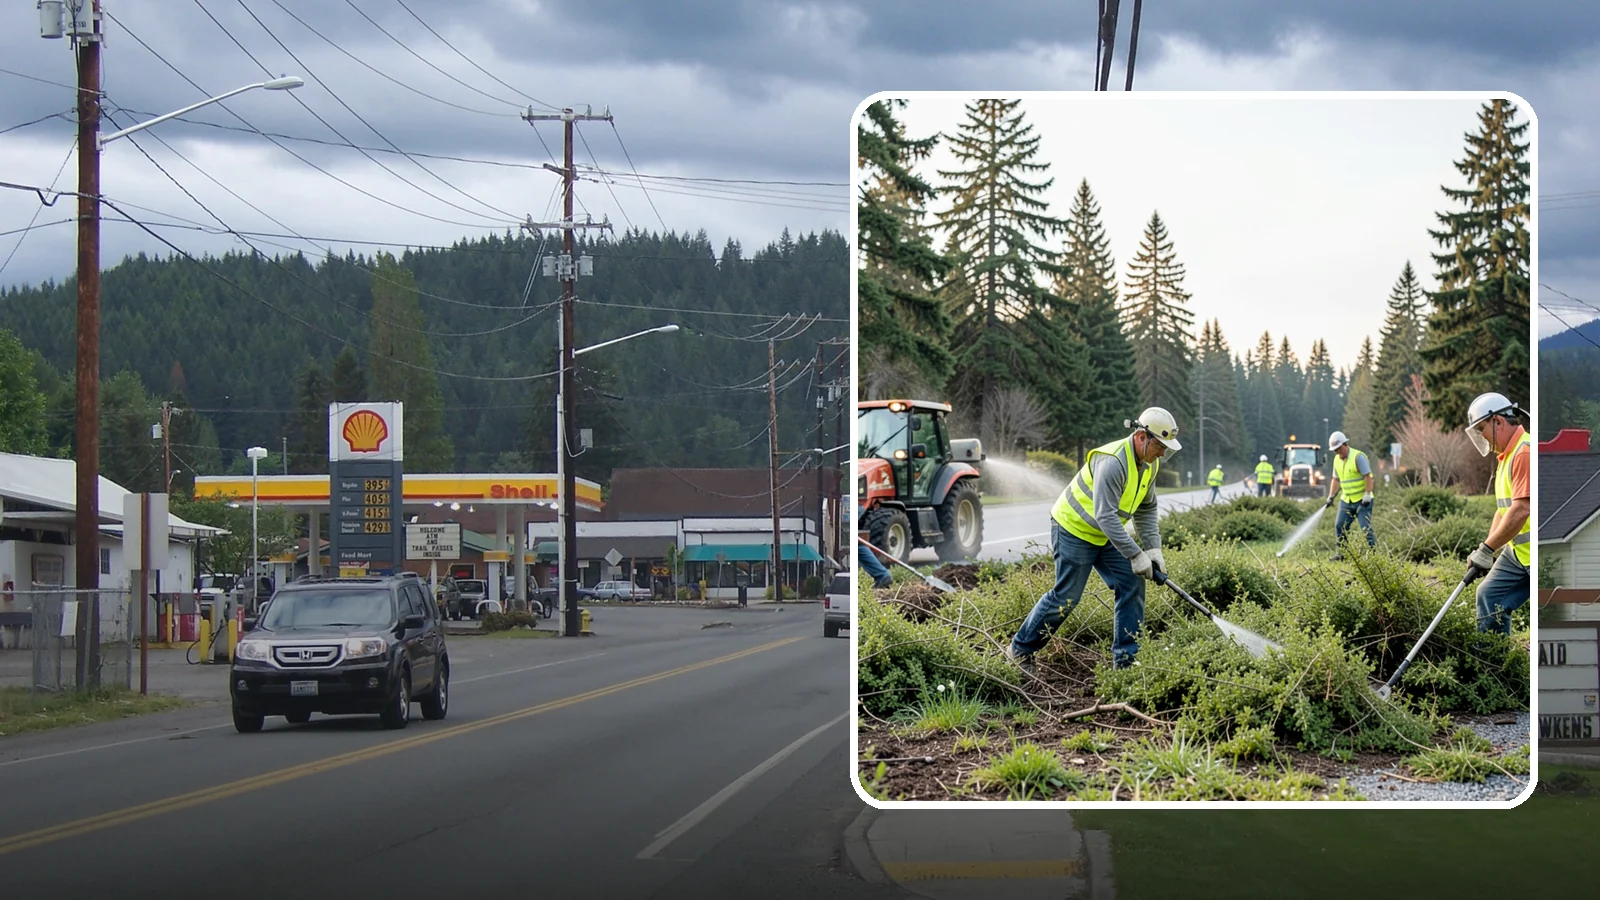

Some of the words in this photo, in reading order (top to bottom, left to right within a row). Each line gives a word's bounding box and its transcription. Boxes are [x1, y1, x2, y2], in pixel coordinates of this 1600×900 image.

[366, 480, 384, 490] 395
[490, 484, 547, 498] Shell
[365, 494, 384, 504] 405
[365, 508, 384, 518] 415
[365, 522, 384, 532] 429
